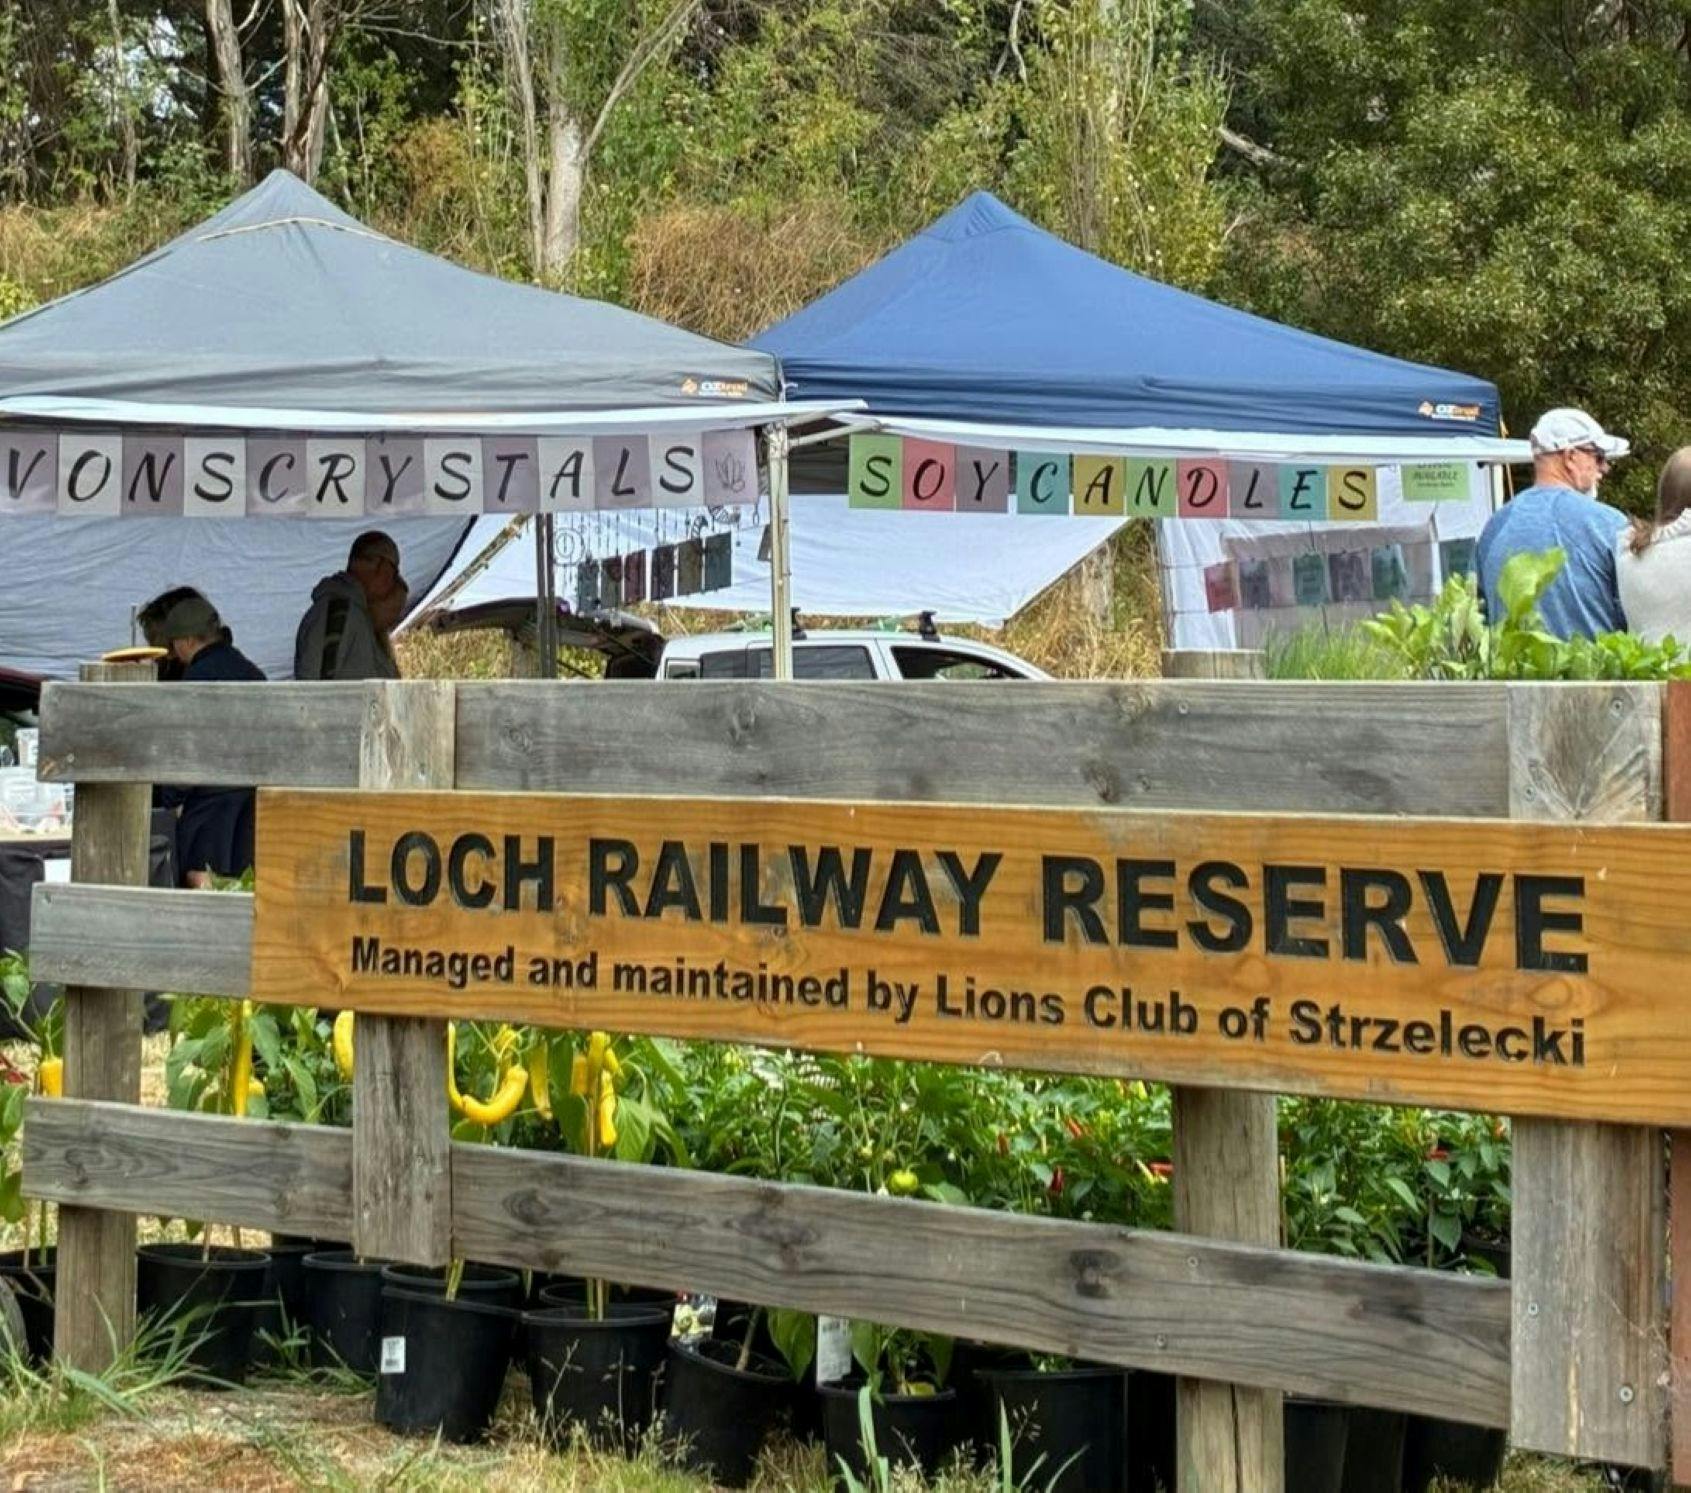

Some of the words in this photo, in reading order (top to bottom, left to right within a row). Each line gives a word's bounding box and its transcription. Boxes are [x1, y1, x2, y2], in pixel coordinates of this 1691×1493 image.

[860, 456, 999, 503] SOY
[1030, 461, 1368, 511] CANDLES
[349, 829, 555, 912] LOCH
[588, 837, 1004, 937] RAILWAY
[1042, 854, 1589, 974] RESERVE
[351, 935, 515, 989] Managed
[528, 950, 598, 989] and
[613, 957, 850, 1008] maintained
[866, 969, 919, 1024] by
[936, 973, 1065, 1026] Lions
[1083, 985, 1198, 1035] Club
[1218, 996, 1271, 1042] of
[1288, 999, 1586, 1067] Strzelecki
